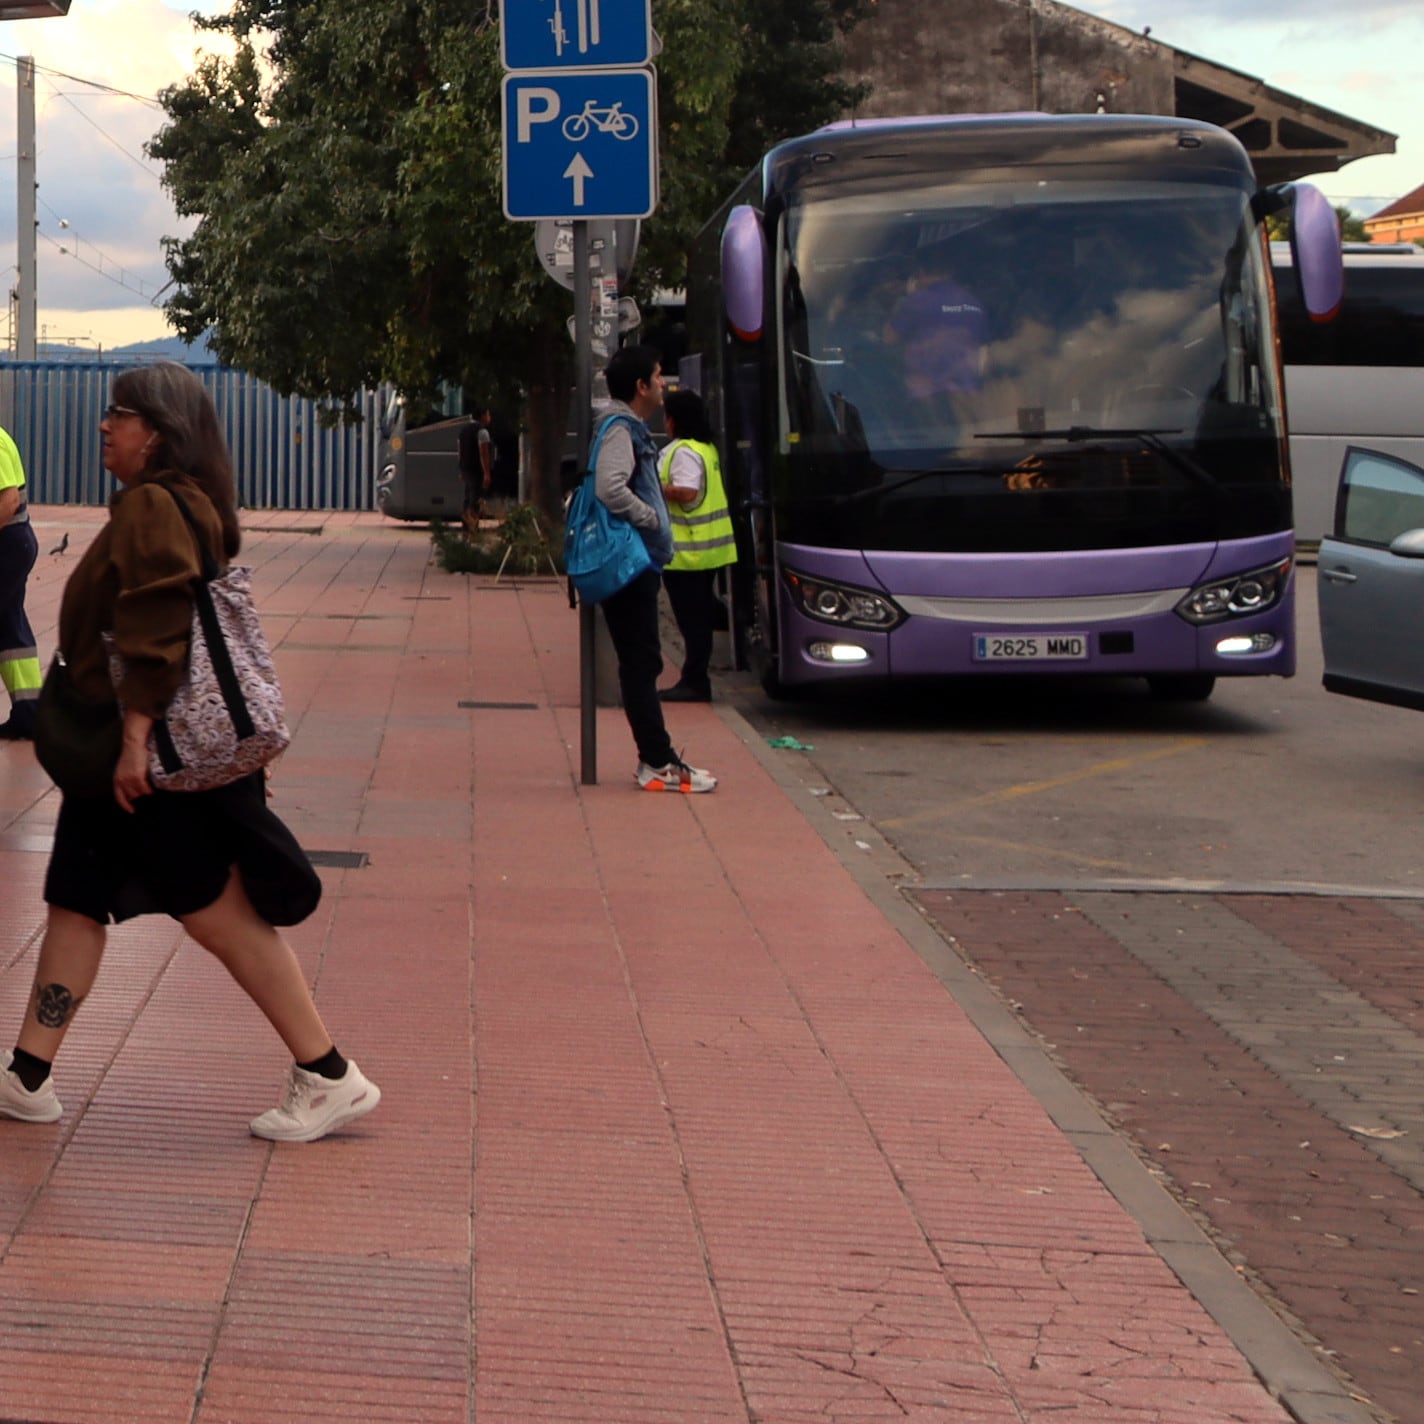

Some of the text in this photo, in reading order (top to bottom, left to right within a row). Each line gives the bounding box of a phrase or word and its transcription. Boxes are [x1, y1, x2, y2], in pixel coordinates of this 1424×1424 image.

[517, 87, 561, 143] P
[992, 638, 1082, 656] 2625 MMD
